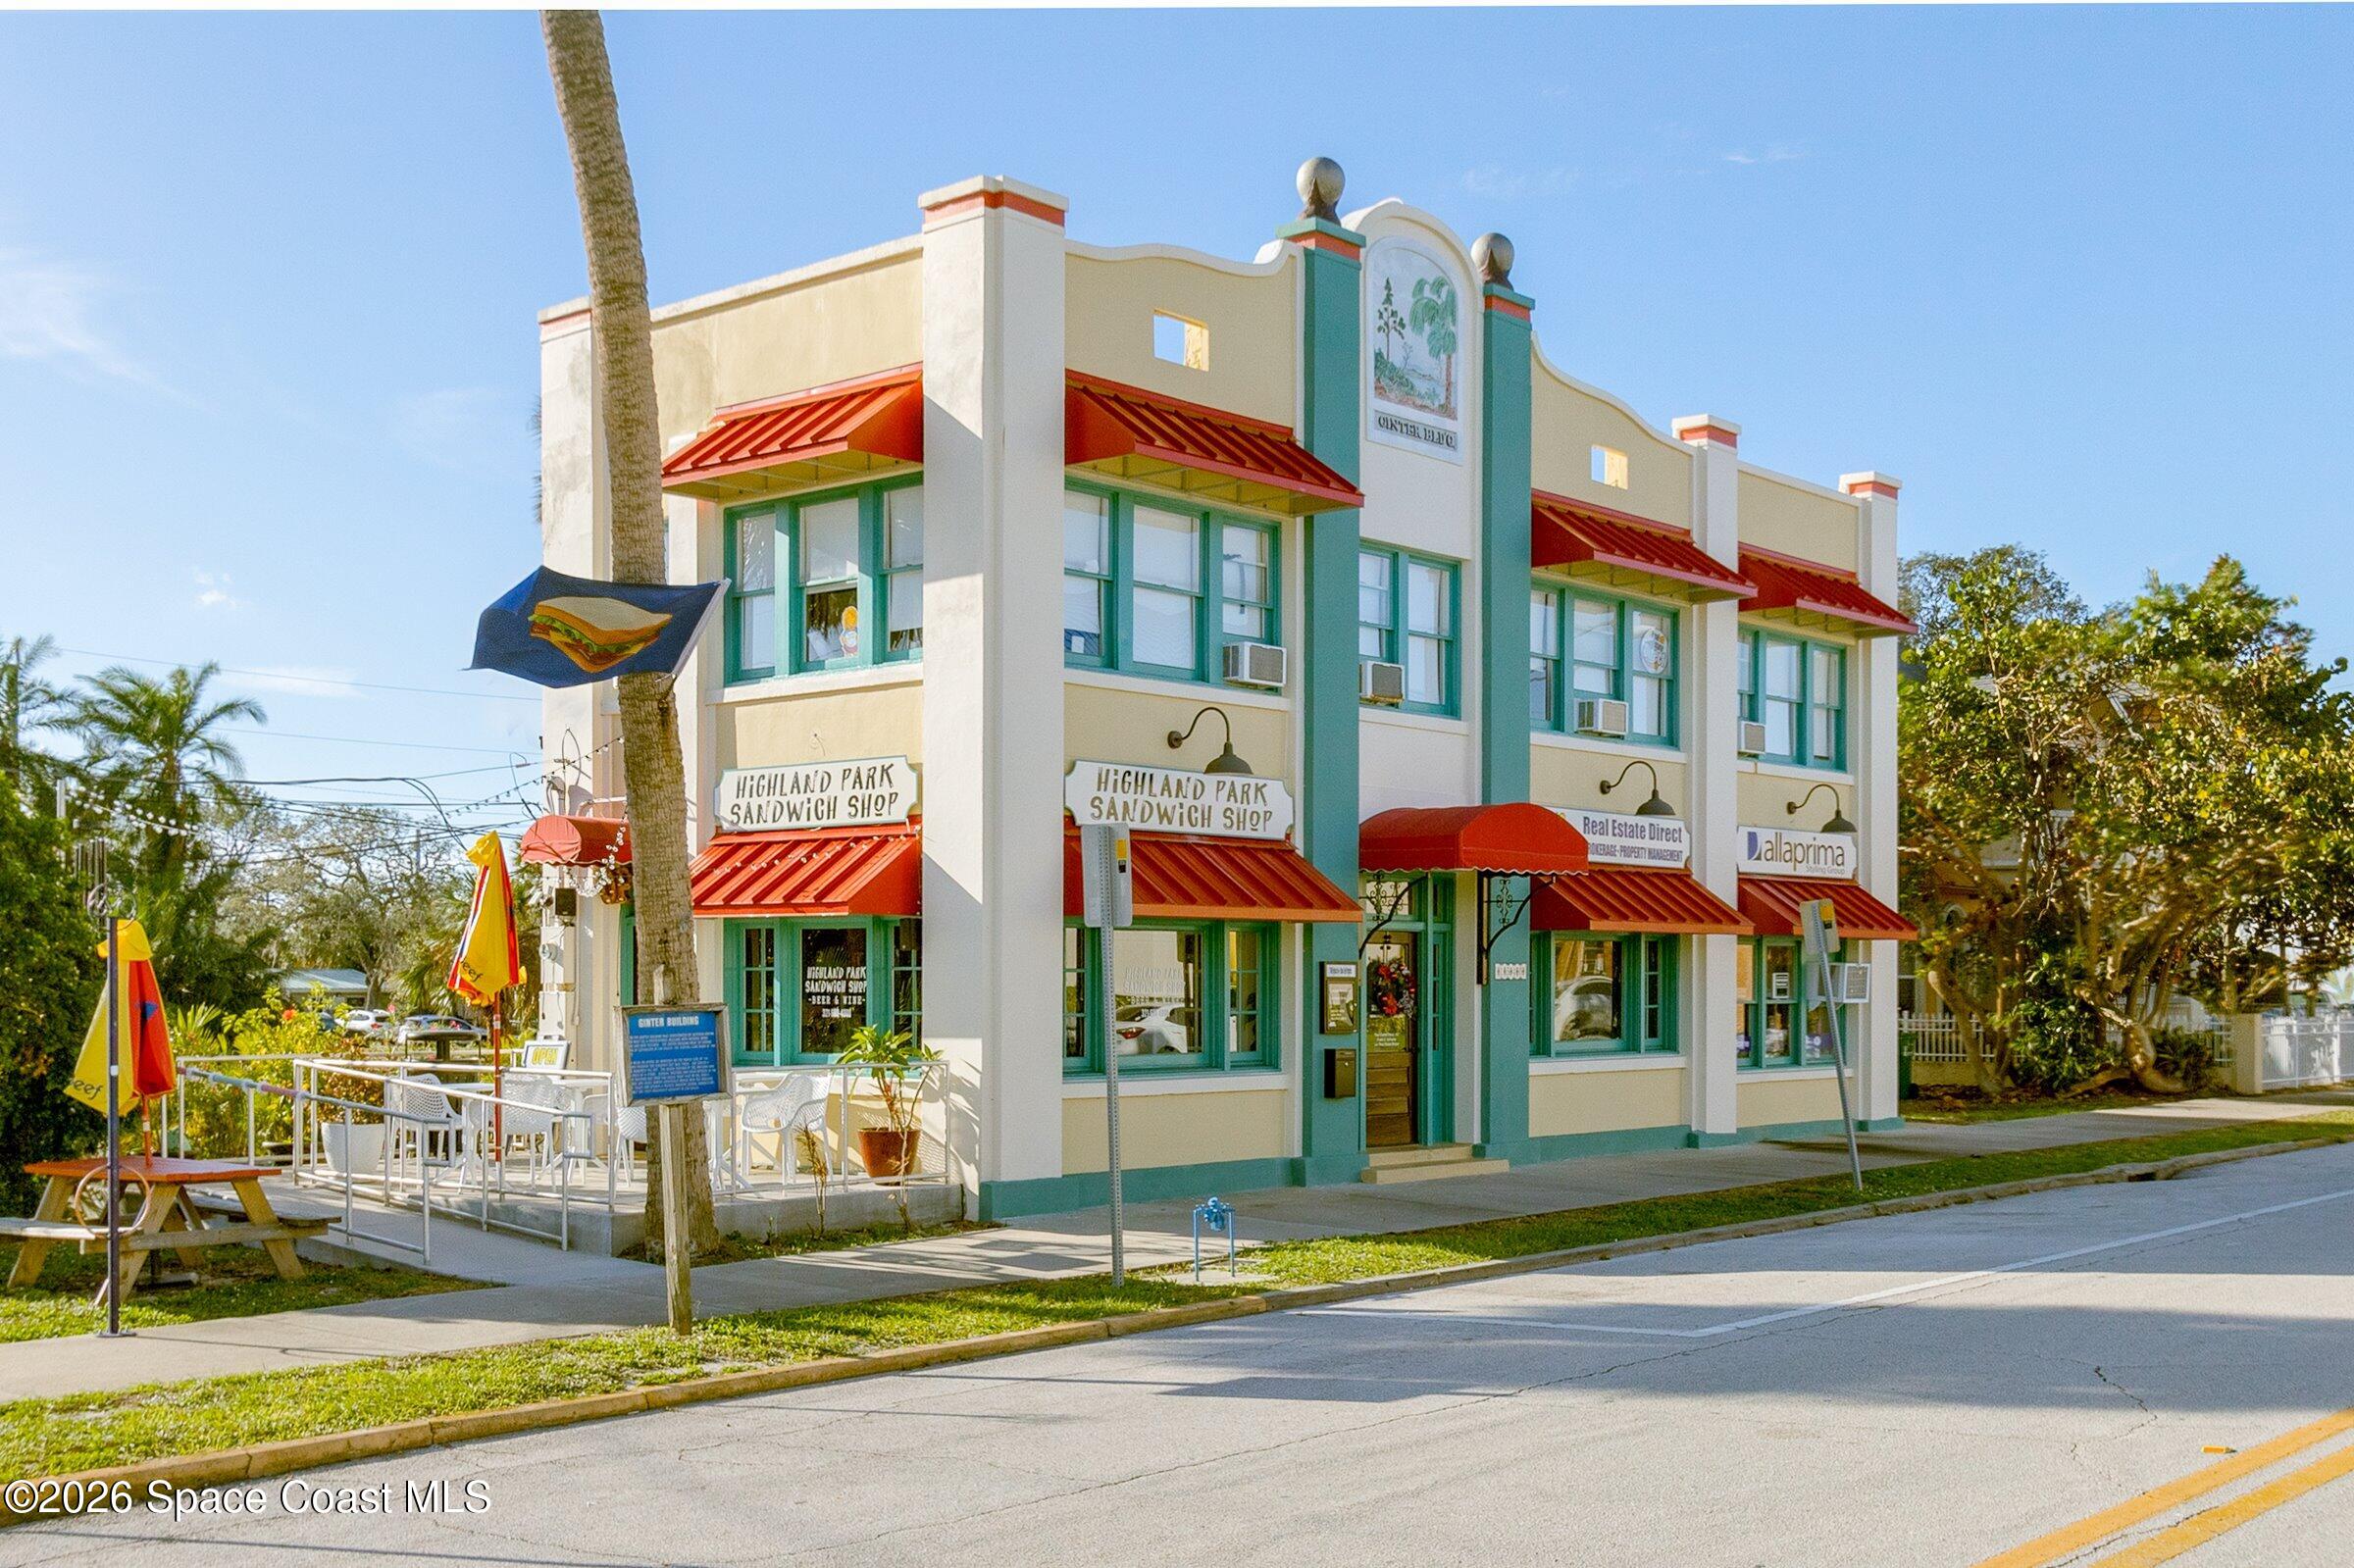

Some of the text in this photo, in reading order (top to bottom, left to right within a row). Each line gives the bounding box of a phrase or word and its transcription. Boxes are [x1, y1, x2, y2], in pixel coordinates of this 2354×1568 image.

[736, 763, 895, 800] HIGHLAND PARK
[1097, 766, 1268, 807] HIGHLAND PARK
[730, 792, 898, 826] SANDWICH SHOP
[1091, 796, 1273, 832] SANDWICH SHOP
[1583, 817, 1682, 843] Real Estate Direct
[1648, 847, 1683, 863] MANAGEMENT
[1764, 832, 1845, 872] allaprima
[667, 1015, 699, 1028] BUILDING
[533, 1046, 558, 1065] OPEN
